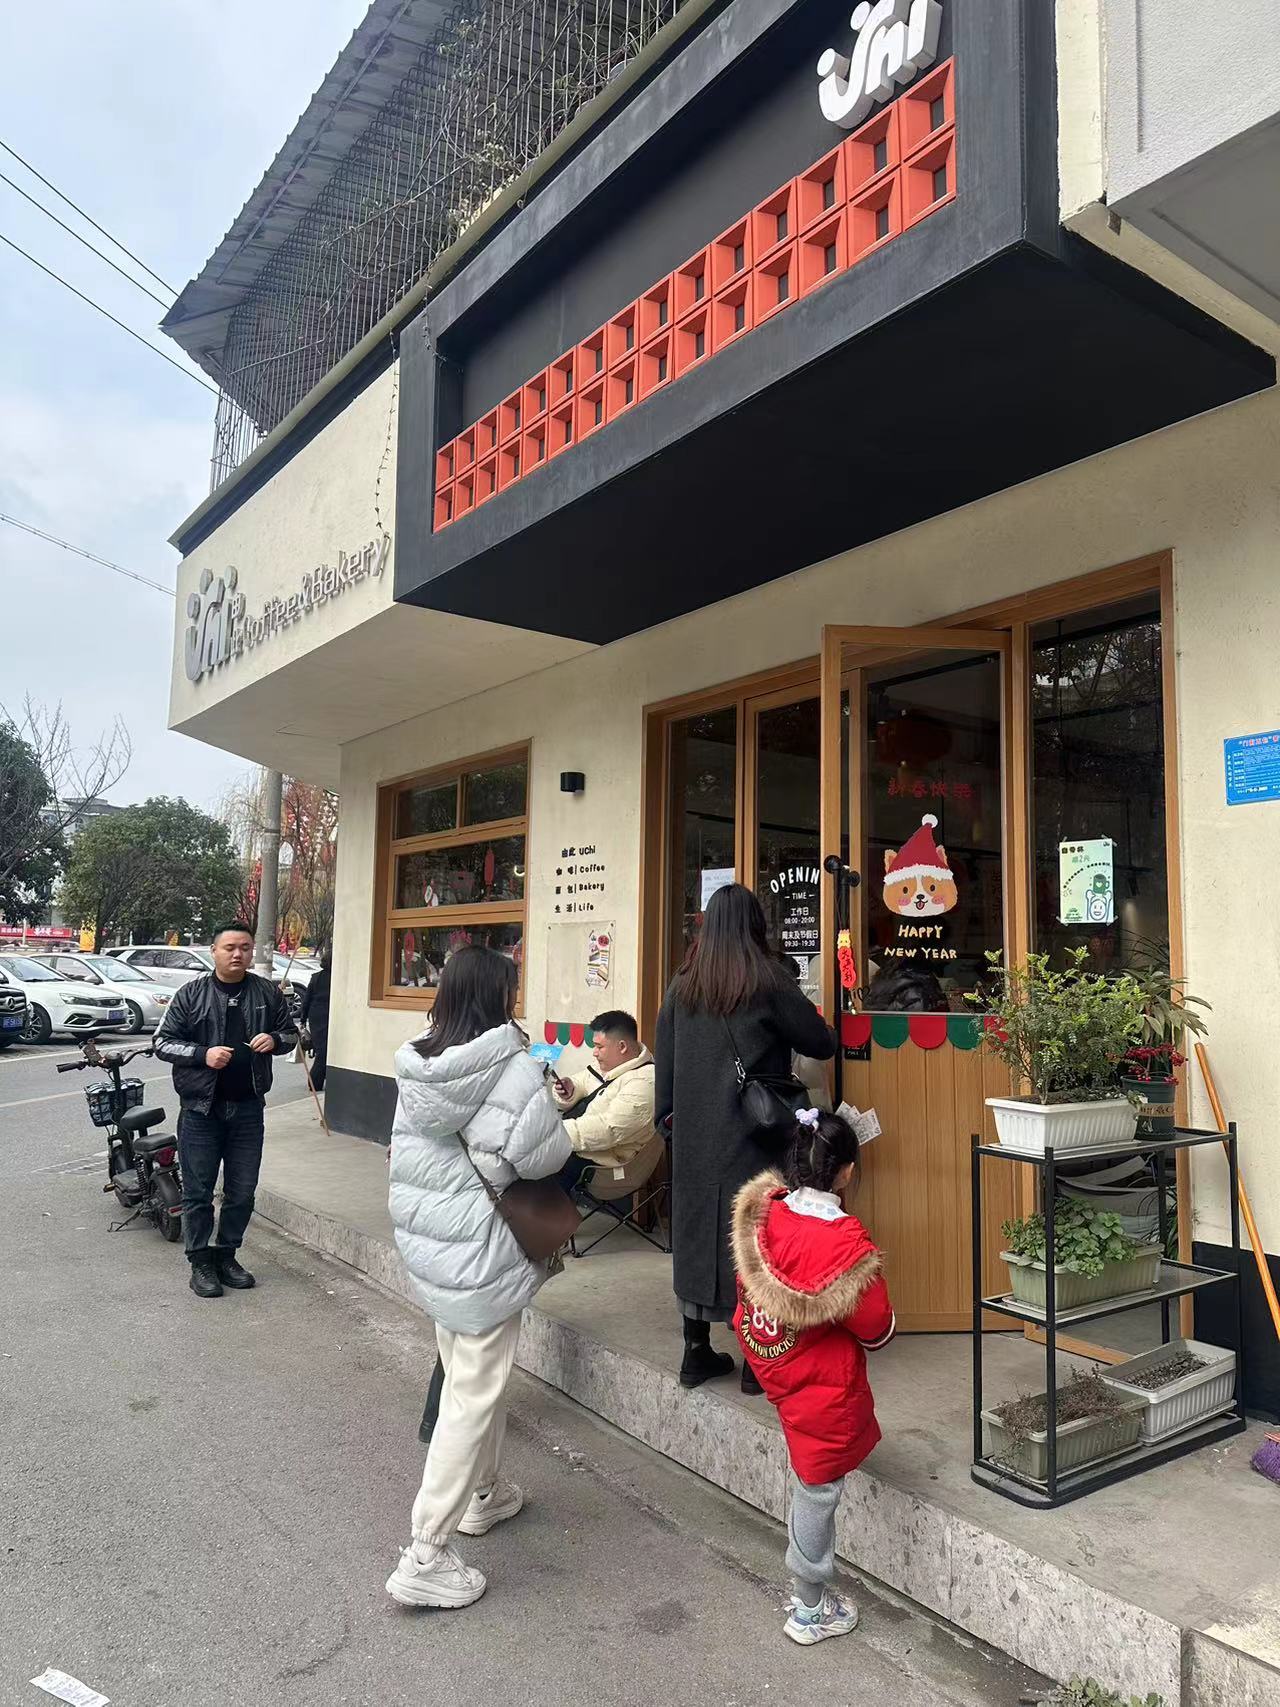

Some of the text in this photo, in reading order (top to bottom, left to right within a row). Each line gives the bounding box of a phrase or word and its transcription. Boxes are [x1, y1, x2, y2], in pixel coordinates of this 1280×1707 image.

[579, 863, 605, 873] Coffee
[579, 882, 605, 892] Bakery
[792, 892, 807, 900] TIME
[578, 902, 594, 912] Life
[790, 906, 809, 917] 工作日
[898, 924, 943, 939] HAPPY
[884, 947, 958, 960] NEW YEAR
